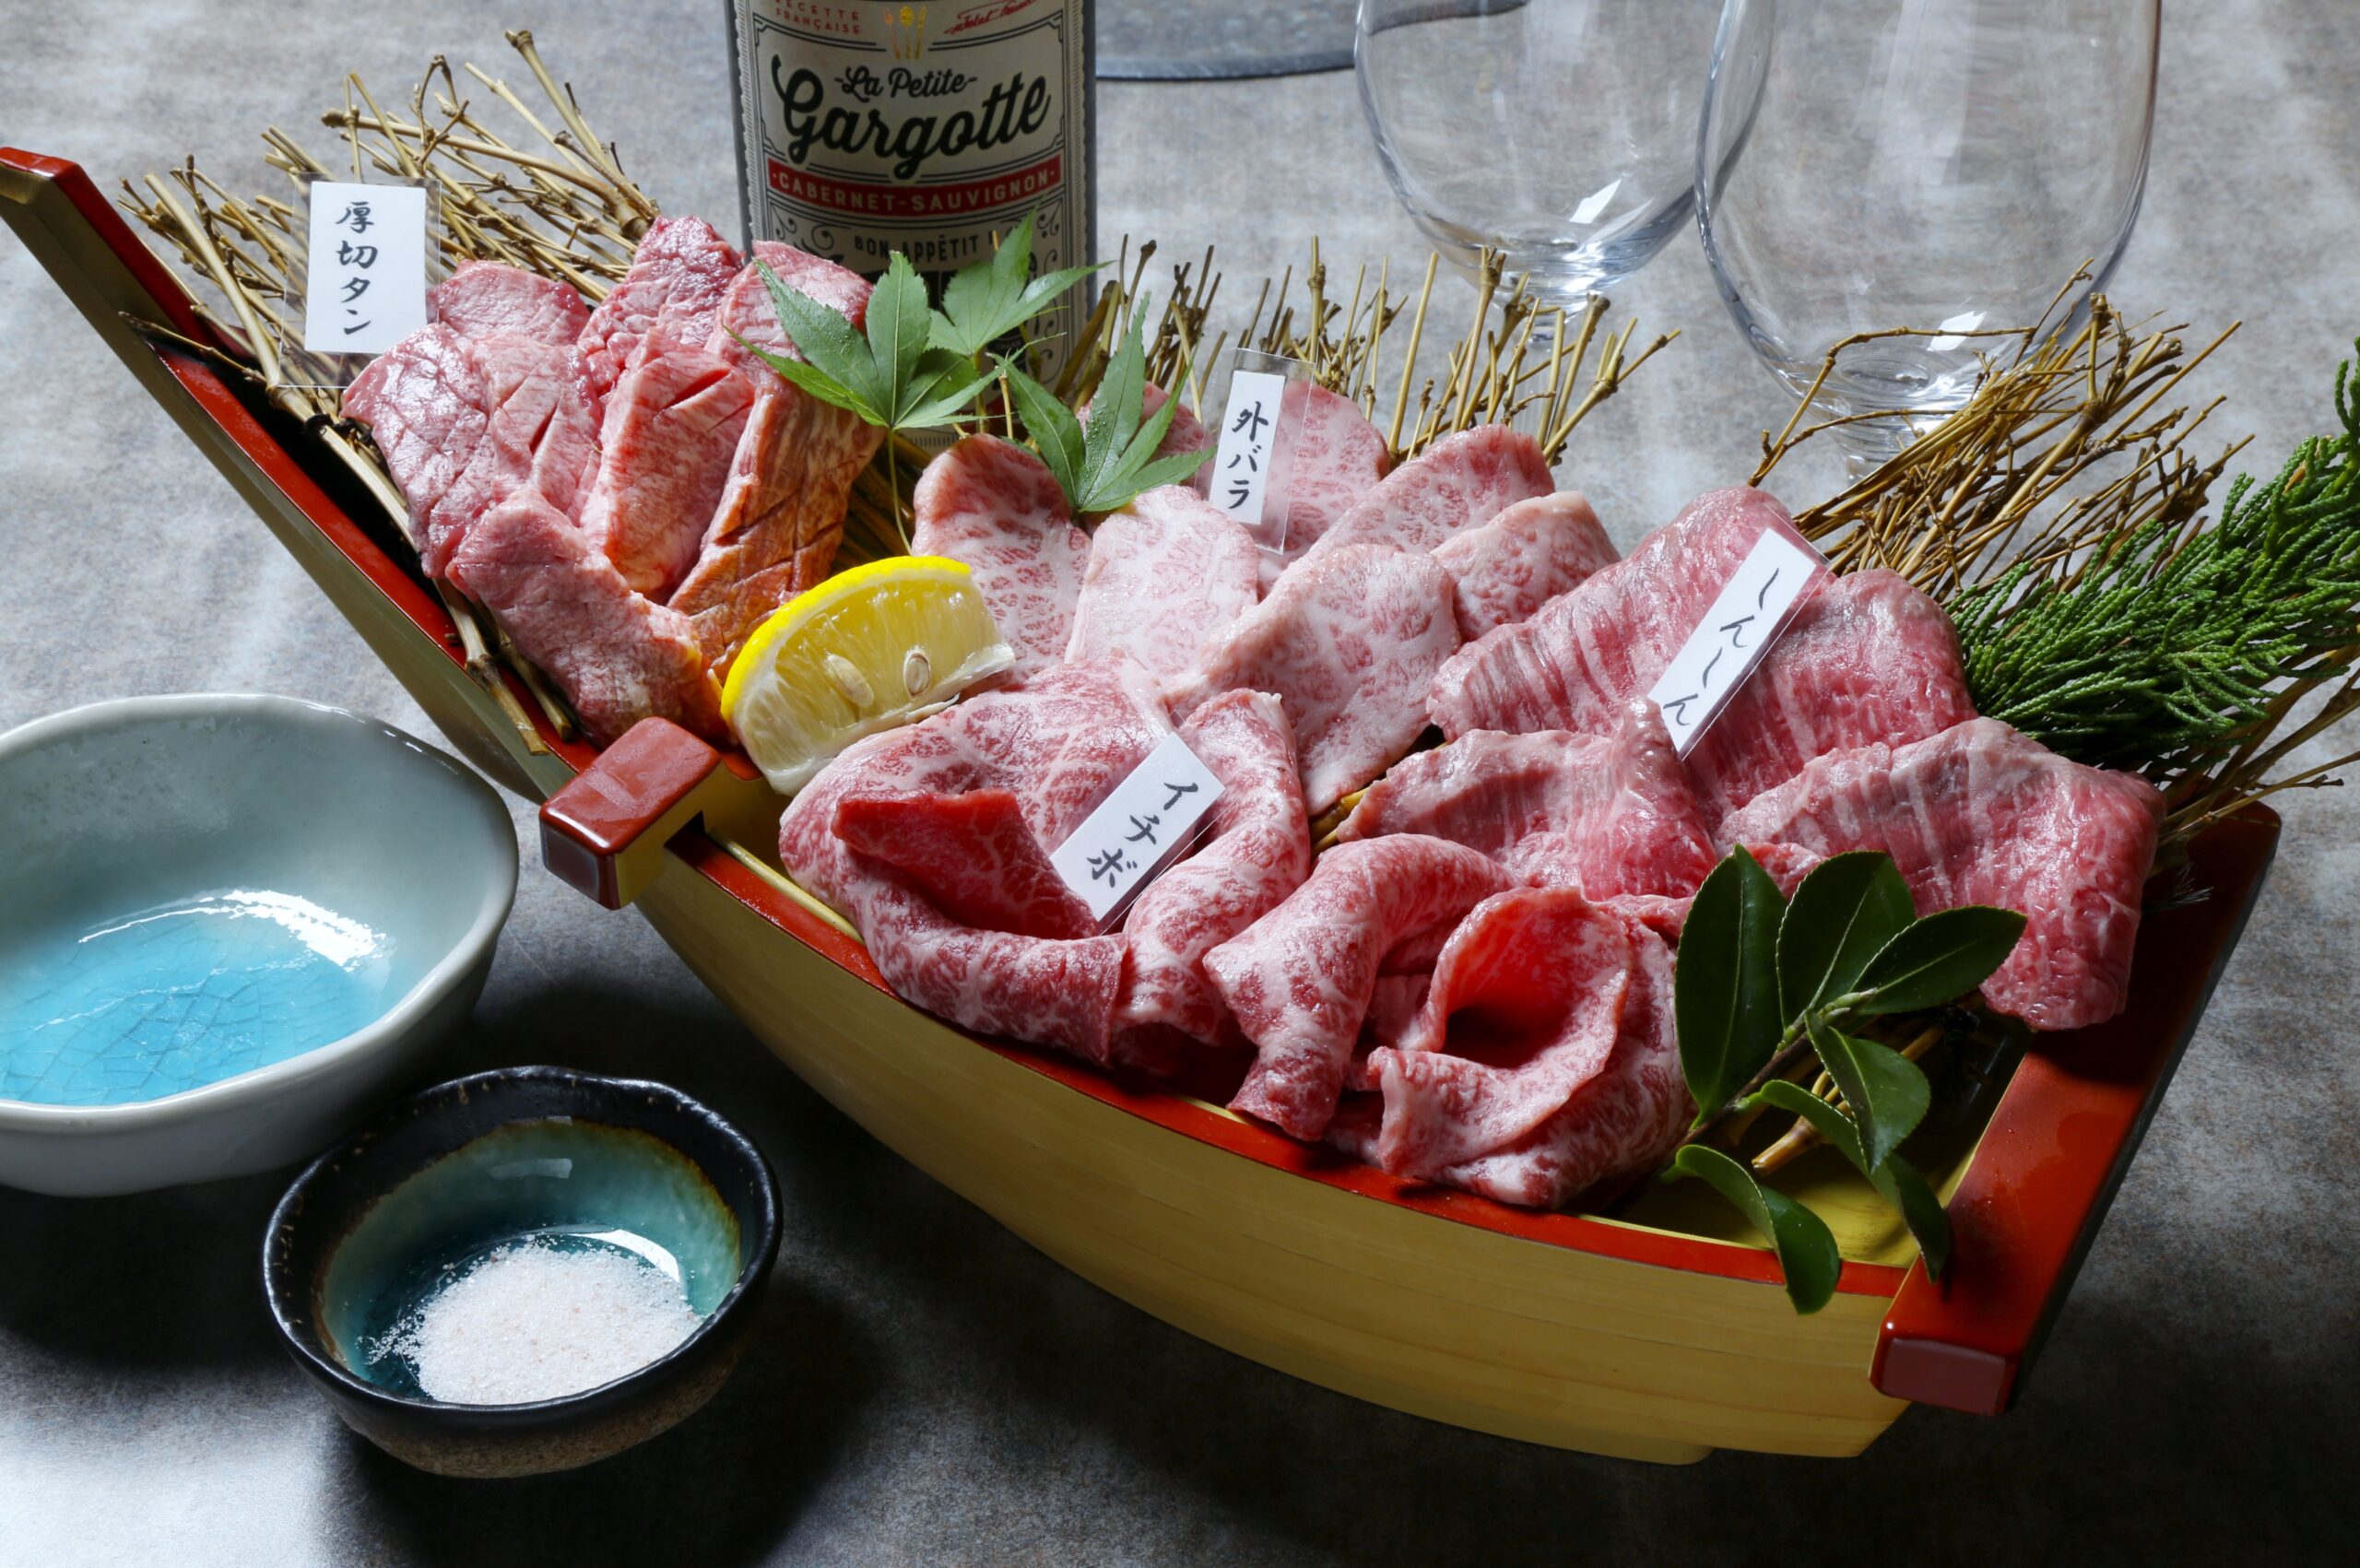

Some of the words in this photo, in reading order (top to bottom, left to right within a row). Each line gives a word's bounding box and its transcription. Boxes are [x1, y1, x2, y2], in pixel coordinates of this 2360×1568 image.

[775, 7, 860, 35] FRANÇAISE
[771, 53, 1052, 181] Gargotte
[840, 65, 884, 103] La
[888, 67, 971, 98] Petite
[778, 169, 1048, 212] CABERNET-SAUVIGNON
[335, 200, 379, 335] 厚切タン
[854, 235, 891, 259] BON
[1227, 400, 1269, 510] 外バラ
[1662, 567, 1780, 727] しんしん
[1086, 782, 1198, 889] イチボ
